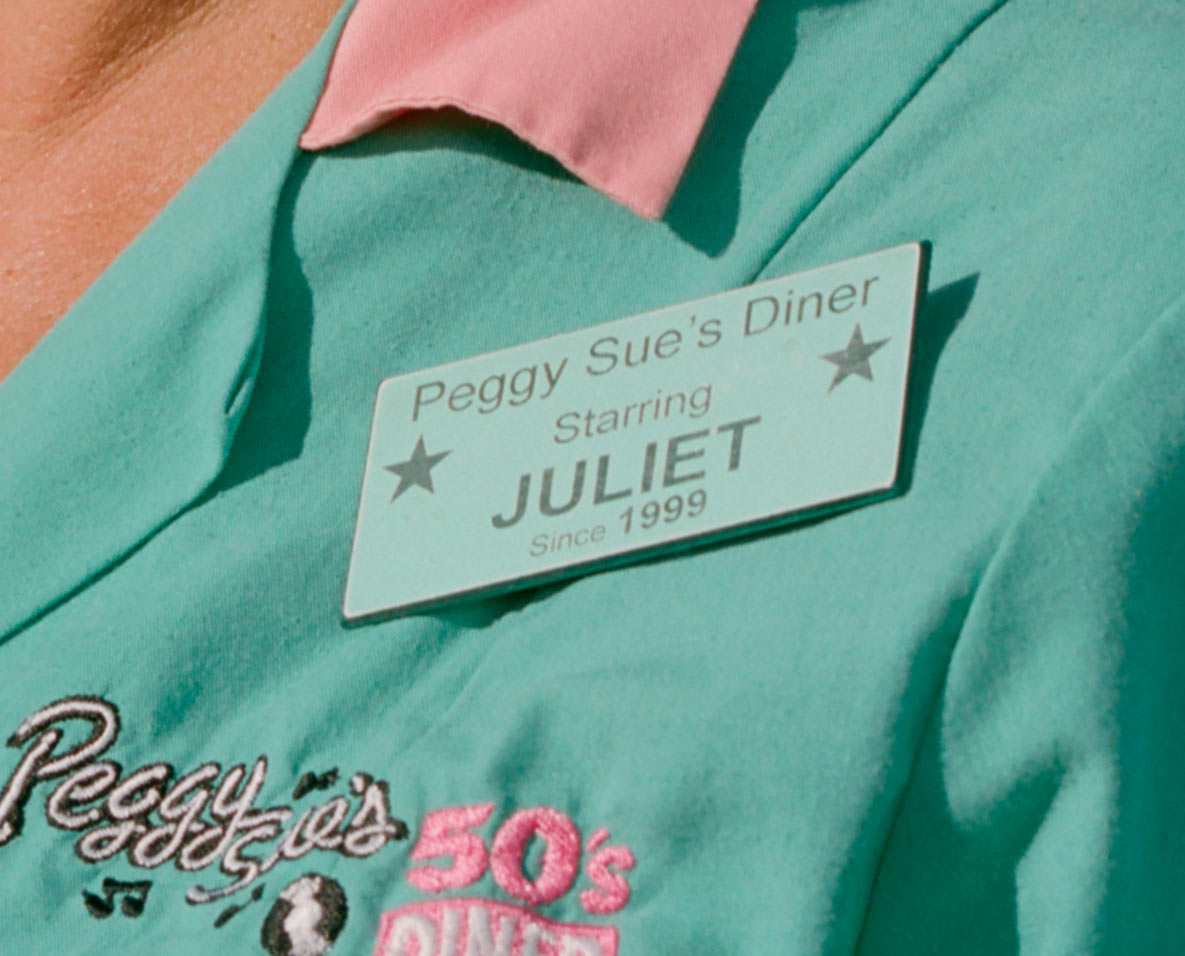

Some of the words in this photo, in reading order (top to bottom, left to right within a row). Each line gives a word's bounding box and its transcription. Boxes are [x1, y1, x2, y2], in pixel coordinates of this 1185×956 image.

[411, 356, 569, 423] Peggy
[587, 315, 723, 378] Sue's
[742, 275, 881, 337] Diner
[552, 384, 713, 445] Starring
[490, 416, 763, 530] JULIET
[529, 522, 607, 558] Since
[619, 489, 708, 535] 1999
[405, 802, 637, 916] 50's
